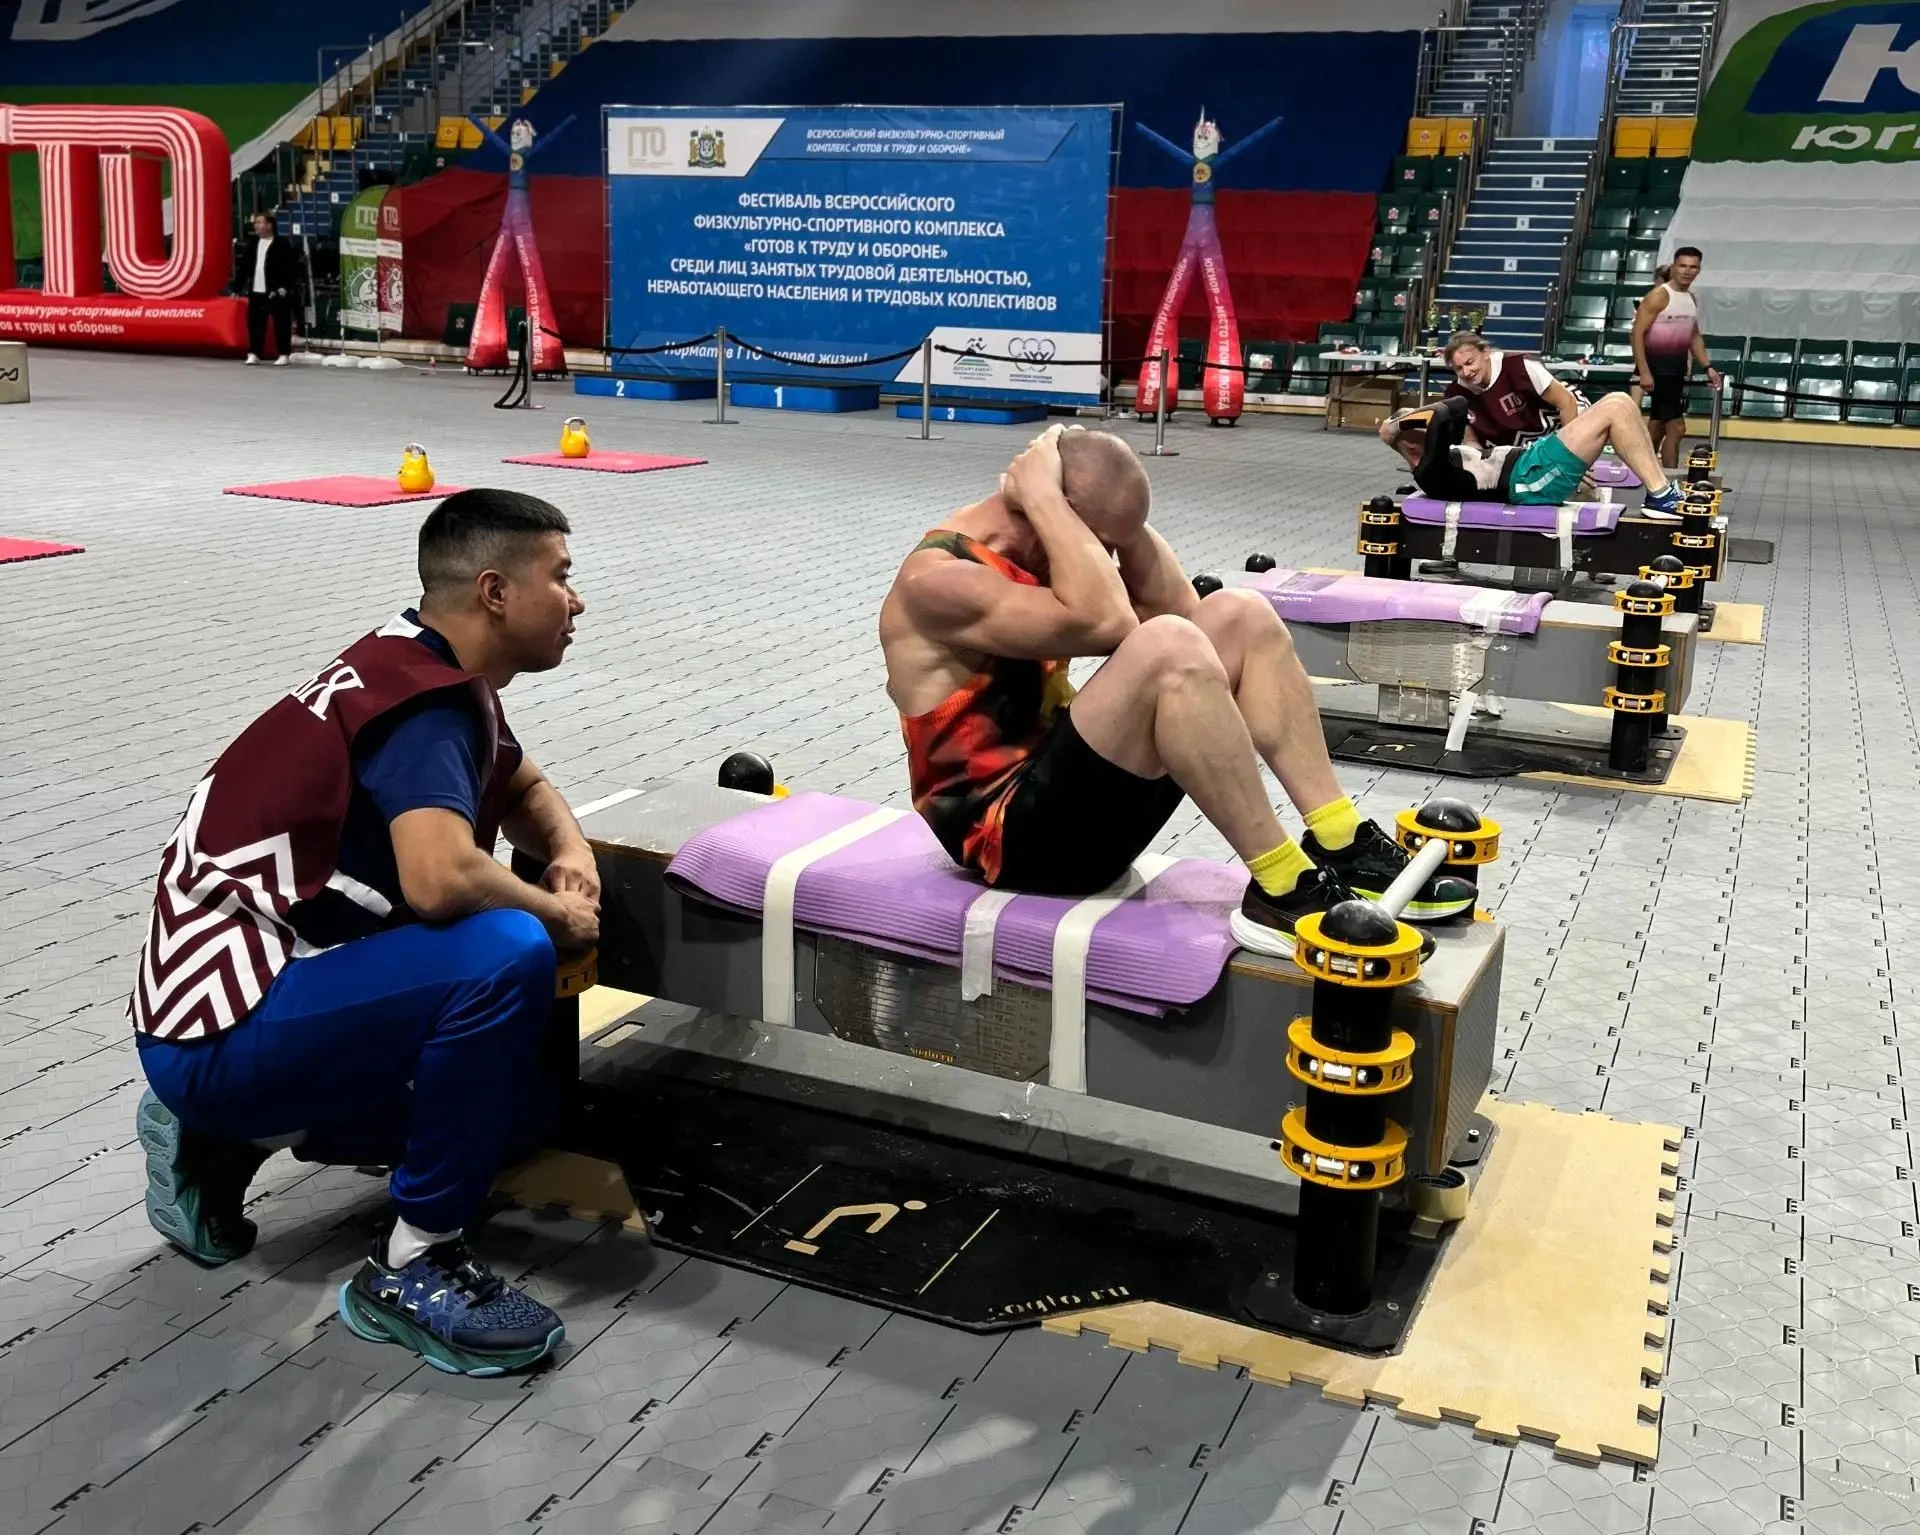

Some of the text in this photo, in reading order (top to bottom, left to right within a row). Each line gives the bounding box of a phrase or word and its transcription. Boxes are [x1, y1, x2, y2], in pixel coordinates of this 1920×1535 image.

[806, 128, 1005, 141] ВСЕРОССИЙСКИЙ ФИЗКУЛЬТУРНО-СПОРТИВНЫЙ
[1791, 124, 1920, 150] ЮГ
[806, 143, 972, 155] КОМПЛЕКС «ГОТОВ К ТРУДУ И ОБОРОНЕ»
[0, 111, 204, 300] ТО
[738, 193, 955, 212] ФЕСТИВАЛЬ ВСЕРОССИЙСКОГО
[694, 215, 1005, 237] ФИЗКУЛЬТУРНО-СПОРТИВНОГО КОМПЛЕКСА
[744, 239, 948, 260] «ГОТОВ К ТРУДУ И ОБОРОНЕ»
[670, 258, 1031, 288] СРЕДИ ЛИЦ ЗАНЯТЫХ ТРУДОВОЙ ДЕЯТЕЛЬНОСТЬЮ,
[647, 280, 1056, 311] НЕРАБОТАЮЩЕГО НАСЕЛЕНИЯ И ТРУДОВЫХ КОЛЛЕКТИВОВ
[145, 306, 204, 319] комплекс
[15, 322, 22, 331] к
[23, 322, 56, 335] труду
[59, 323, 67, 332] и
[69, 320, 125, 336] обороне»
[664, 341, 733, 359] Норматв
[616, 380, 625, 397] 2
[774, 387, 783, 407] 1
[947, 407, 955, 420] 3
